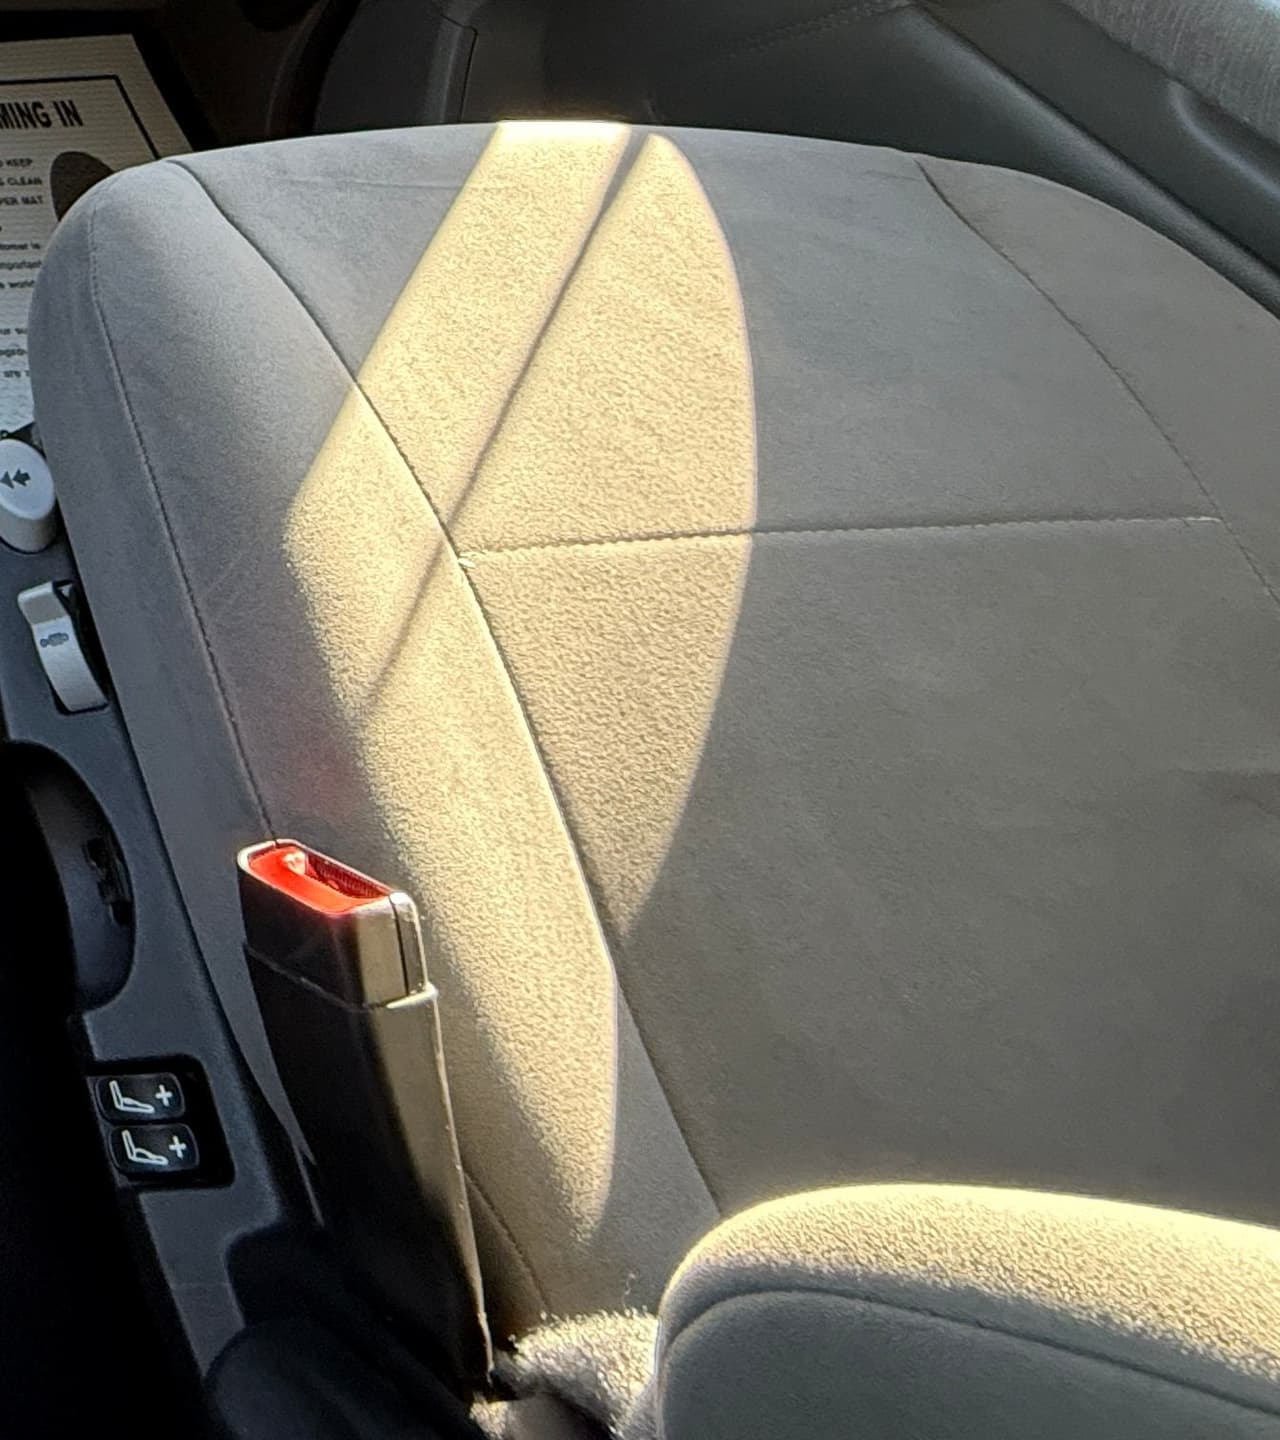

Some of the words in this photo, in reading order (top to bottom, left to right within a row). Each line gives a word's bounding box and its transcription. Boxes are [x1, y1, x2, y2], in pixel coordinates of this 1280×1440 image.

[52, 99, 84, 127] IN
[5, 158, 33, 167] KEEP
[7, 177, 42, 186] CLEAN
[21, 195, 44, 205] MAT
[3, 370, 21, 378] are
